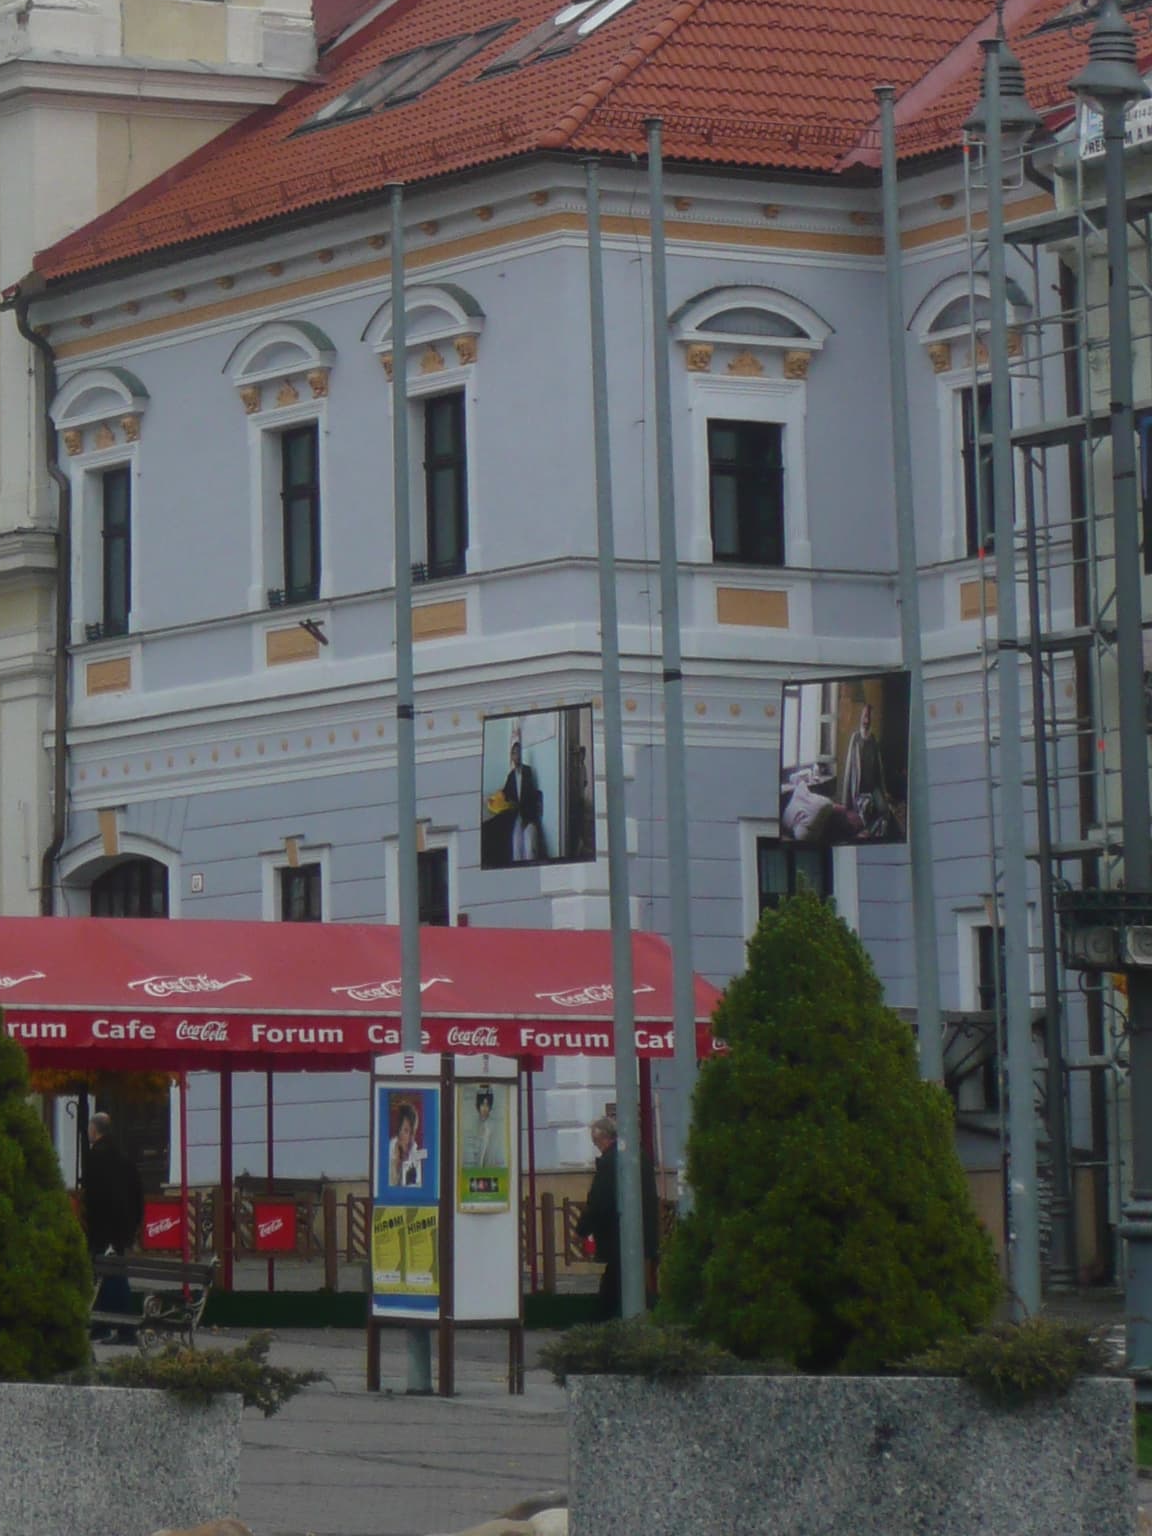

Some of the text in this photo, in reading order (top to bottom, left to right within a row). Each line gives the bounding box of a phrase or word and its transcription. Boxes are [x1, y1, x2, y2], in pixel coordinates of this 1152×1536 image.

[7, 1022, 67, 1038] rum
[92, 1019, 156, 1040] Cafe
[252, 1024, 344, 1044] Forum
[367, 1025, 430, 1045] Cae
[520, 1028, 609, 1049] Forum
[634, 1030, 675, 1050] Caf
